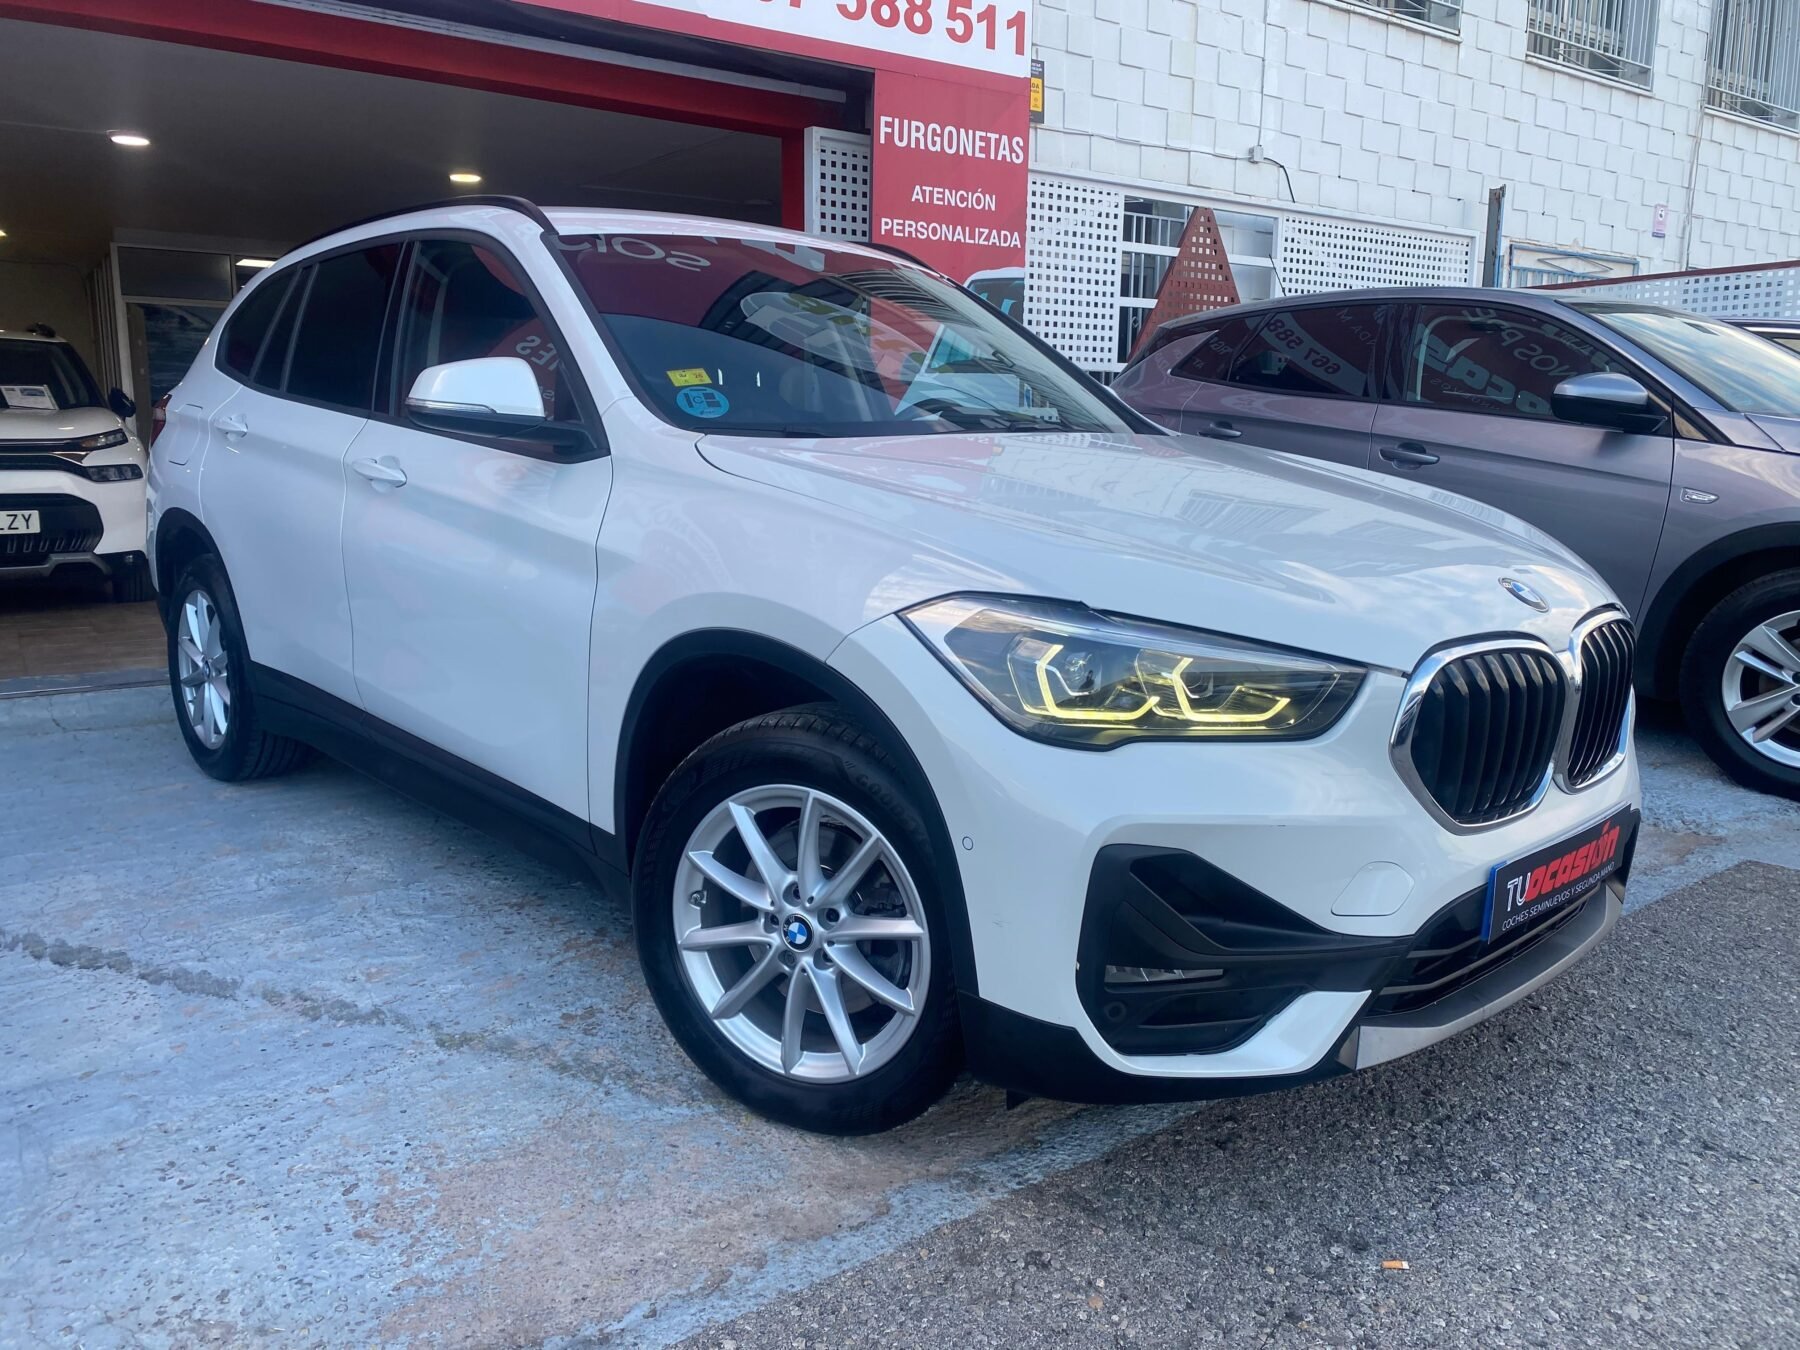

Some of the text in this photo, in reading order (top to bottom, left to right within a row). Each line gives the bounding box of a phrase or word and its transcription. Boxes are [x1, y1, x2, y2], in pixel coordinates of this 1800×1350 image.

[945, 0, 1026, 56] 511
[879, 115, 1024, 164] FURGONETAS
[911, 185, 996, 212] ATENCIÓN
[880, 217, 1022, 249] PERSONALIZADA
[1502, 910, 1529, 931] COCHES
[1530, 889, 1571, 917] SEMINUEVOS
